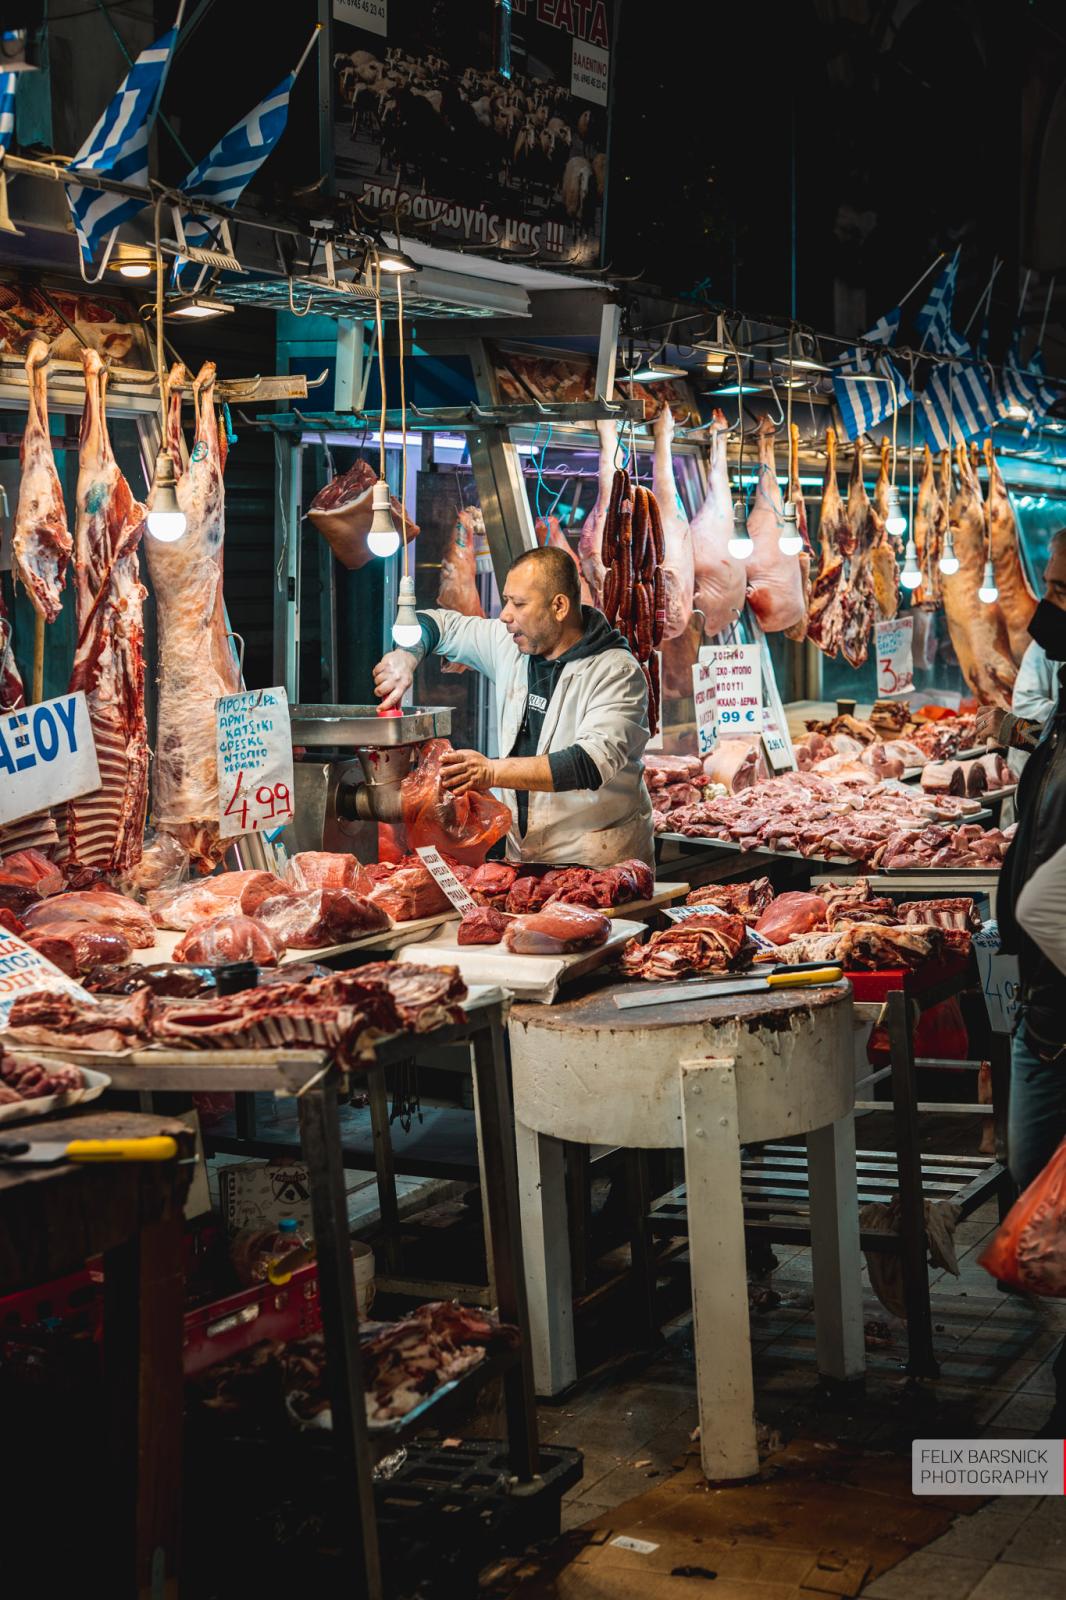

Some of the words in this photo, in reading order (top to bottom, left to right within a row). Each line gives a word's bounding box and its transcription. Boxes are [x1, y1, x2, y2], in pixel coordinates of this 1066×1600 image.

[505, 218, 541, 249] μας
[547, 221, 565, 253] !!!
[225, 720, 273, 739] ΚΑΤΣΙΚΙ
[224, 748, 268, 763] ΝΤΟΠΙΟ
[224, 771, 292, 829] 4,99
